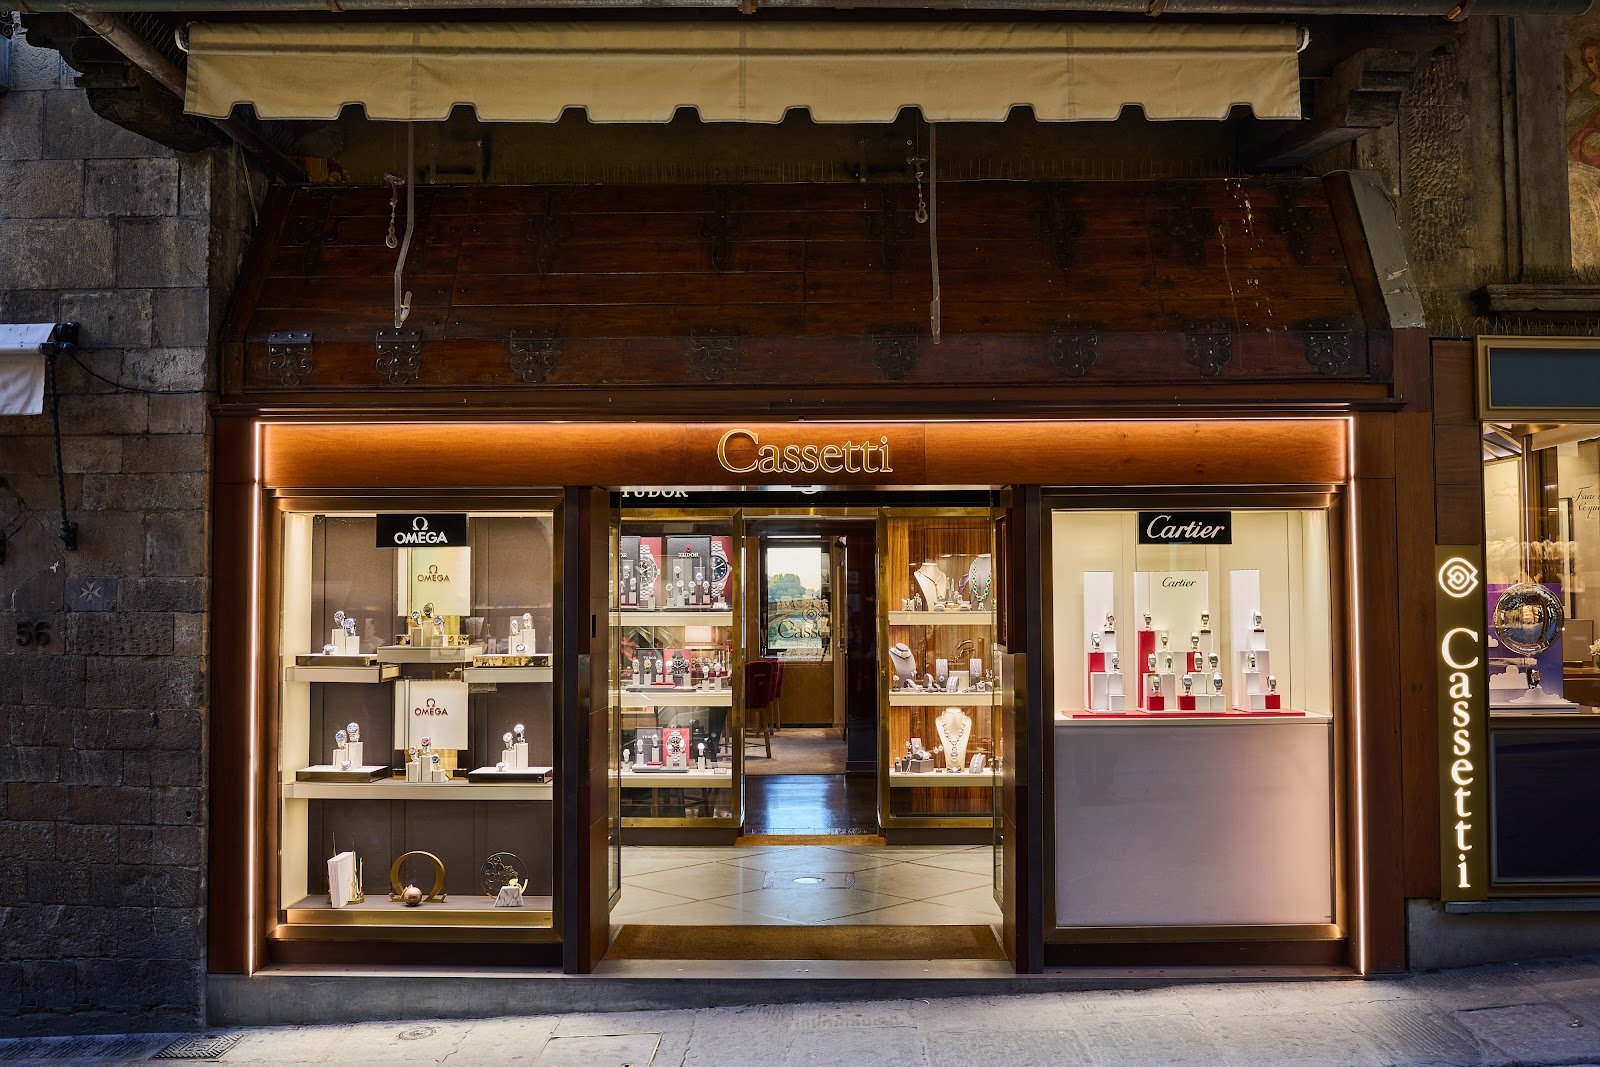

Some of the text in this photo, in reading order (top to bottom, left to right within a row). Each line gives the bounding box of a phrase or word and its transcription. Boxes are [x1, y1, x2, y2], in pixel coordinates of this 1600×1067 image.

[717, 428, 894, 473] Cassetti
[1146, 514, 1226, 539] Cartier
[393, 531, 448, 544] OMEGA
[417, 574, 451, 582] OMEGA
[1162, 576, 1197, 588] Cartier
[414, 707, 449, 716] OMEGA
[1441, 627, 1479, 888] Cassetti
